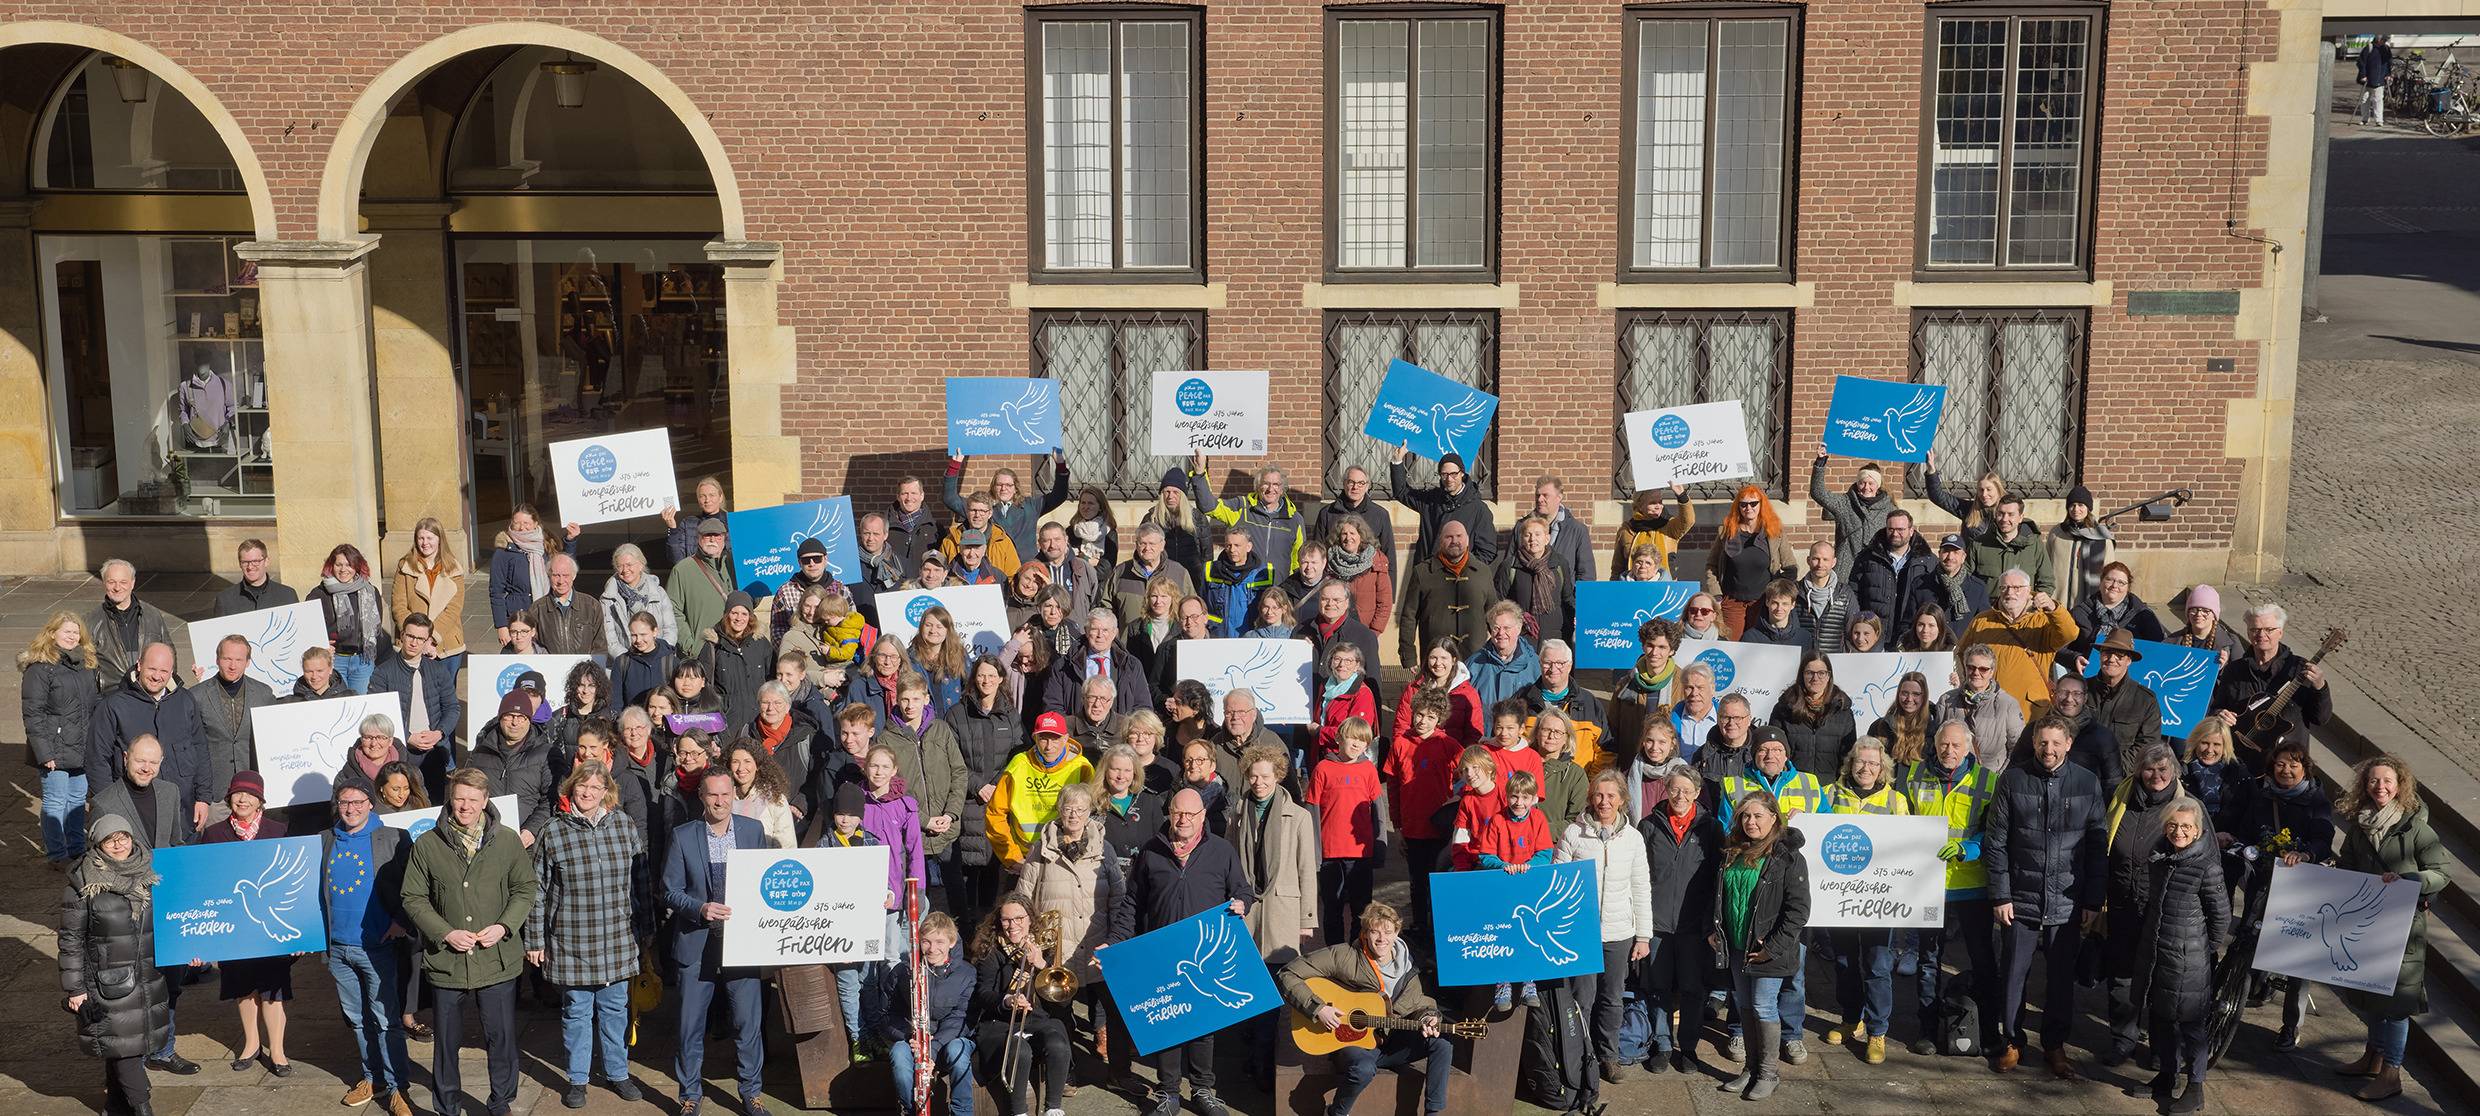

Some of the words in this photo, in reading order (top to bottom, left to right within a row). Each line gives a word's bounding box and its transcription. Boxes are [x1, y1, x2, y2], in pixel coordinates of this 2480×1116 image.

[1387, 415, 1422, 434] Frieden
[965, 427, 1000, 437] Frieden
[1842, 429, 1878, 441] Frieden
[1189, 434, 1243, 449] Frieden
[1672, 461, 1728, 478] Frieden
[599, 496, 654, 515] Frieden
[755, 563, 794, 577] Frieden
[1594, 638, 1632, 649] Frieden
[1026, 777, 1050, 789] SGV
[1825, 841, 1858, 854] PEACE
[1873, 868, 1888, 877] 375
[1891, 868, 1914, 876] Jahre
[765, 878, 799, 890] PEACE
[814, 902, 829, 912] 375
[832, 902, 855, 910] Jahre
[1837, 898, 1912, 919] Frieden
[180, 920, 235, 937] Frieden
[2281, 926, 2311, 939] Frieden
[777, 934, 853, 955] Frieden
[1461, 944, 1514, 959] Frieden
[1146, 1002, 1192, 1024] Frieden
